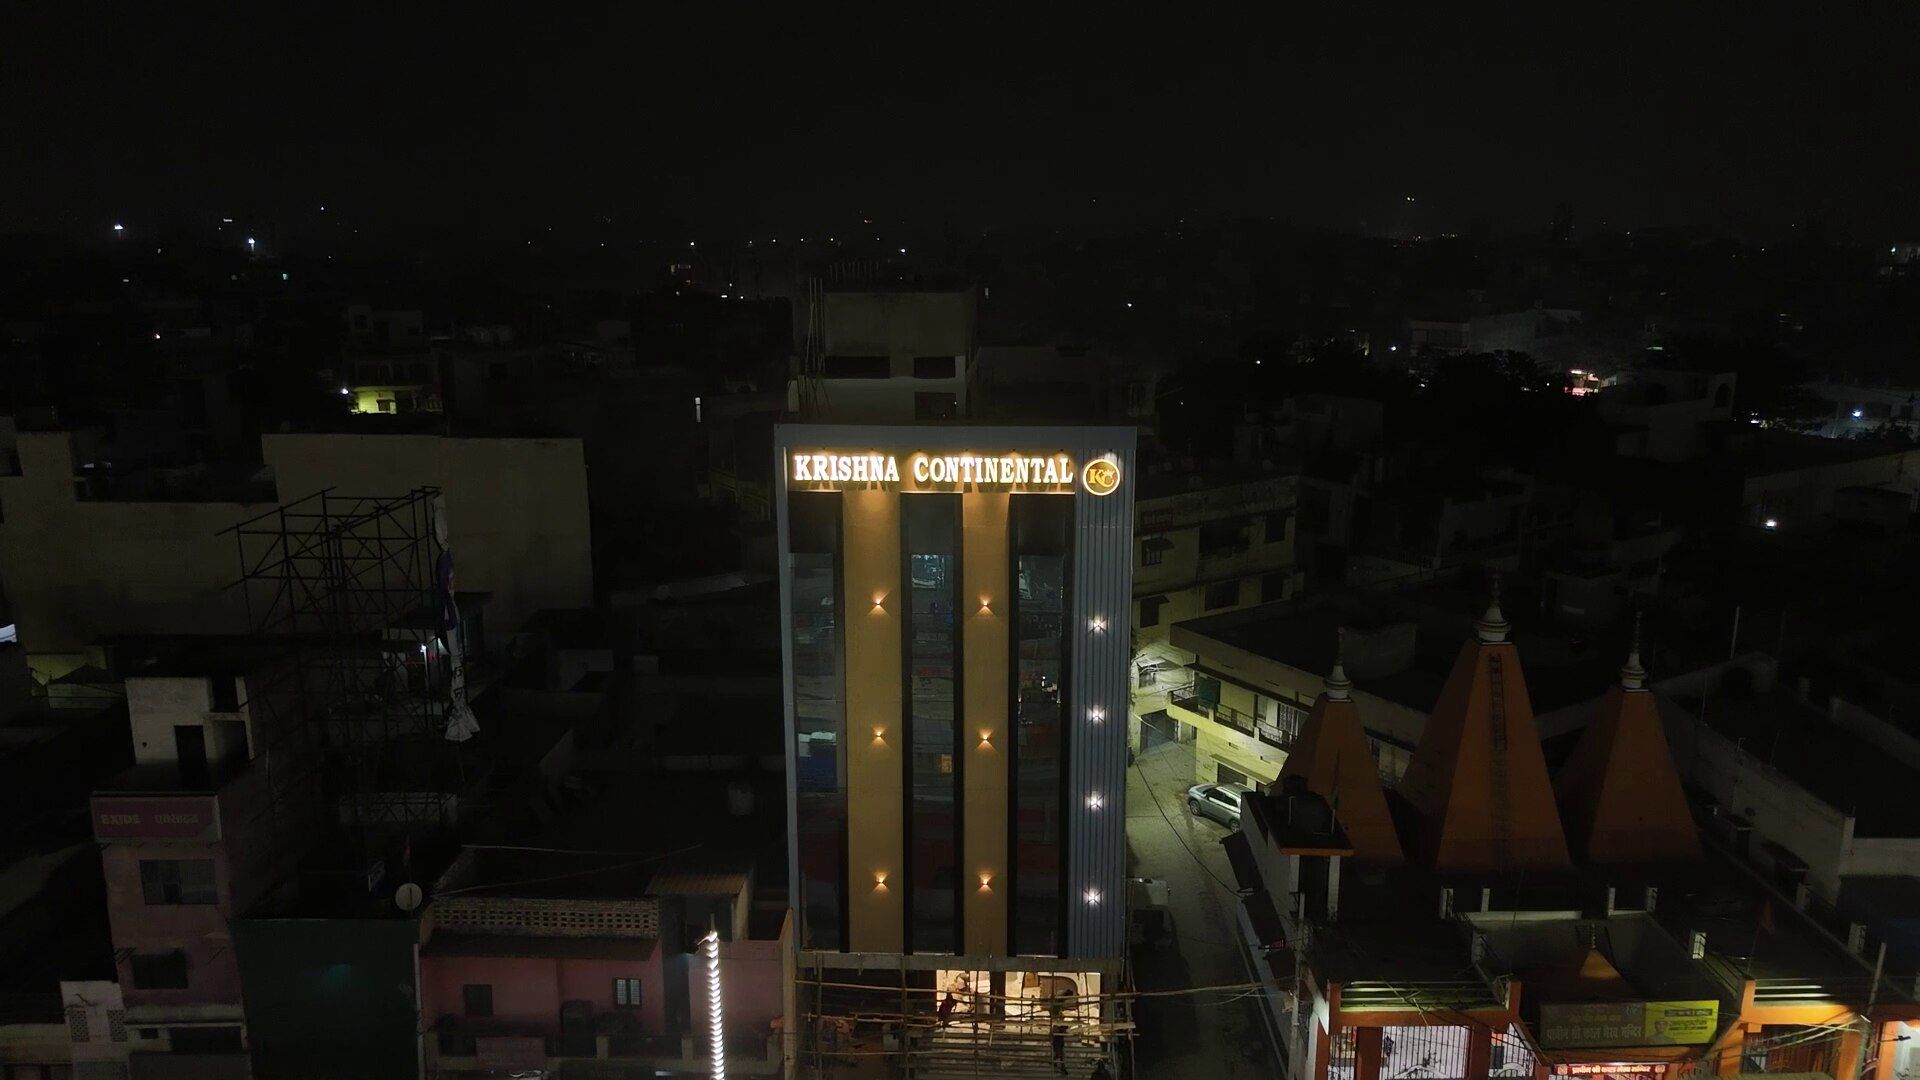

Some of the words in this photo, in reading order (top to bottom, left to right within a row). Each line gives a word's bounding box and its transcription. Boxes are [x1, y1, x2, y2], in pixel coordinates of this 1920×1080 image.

[794, 454, 900, 482] KRISHNA
[914, 455, 1074, 484] CONTINENTAL
[100, 813, 143, 825] EXIDE
